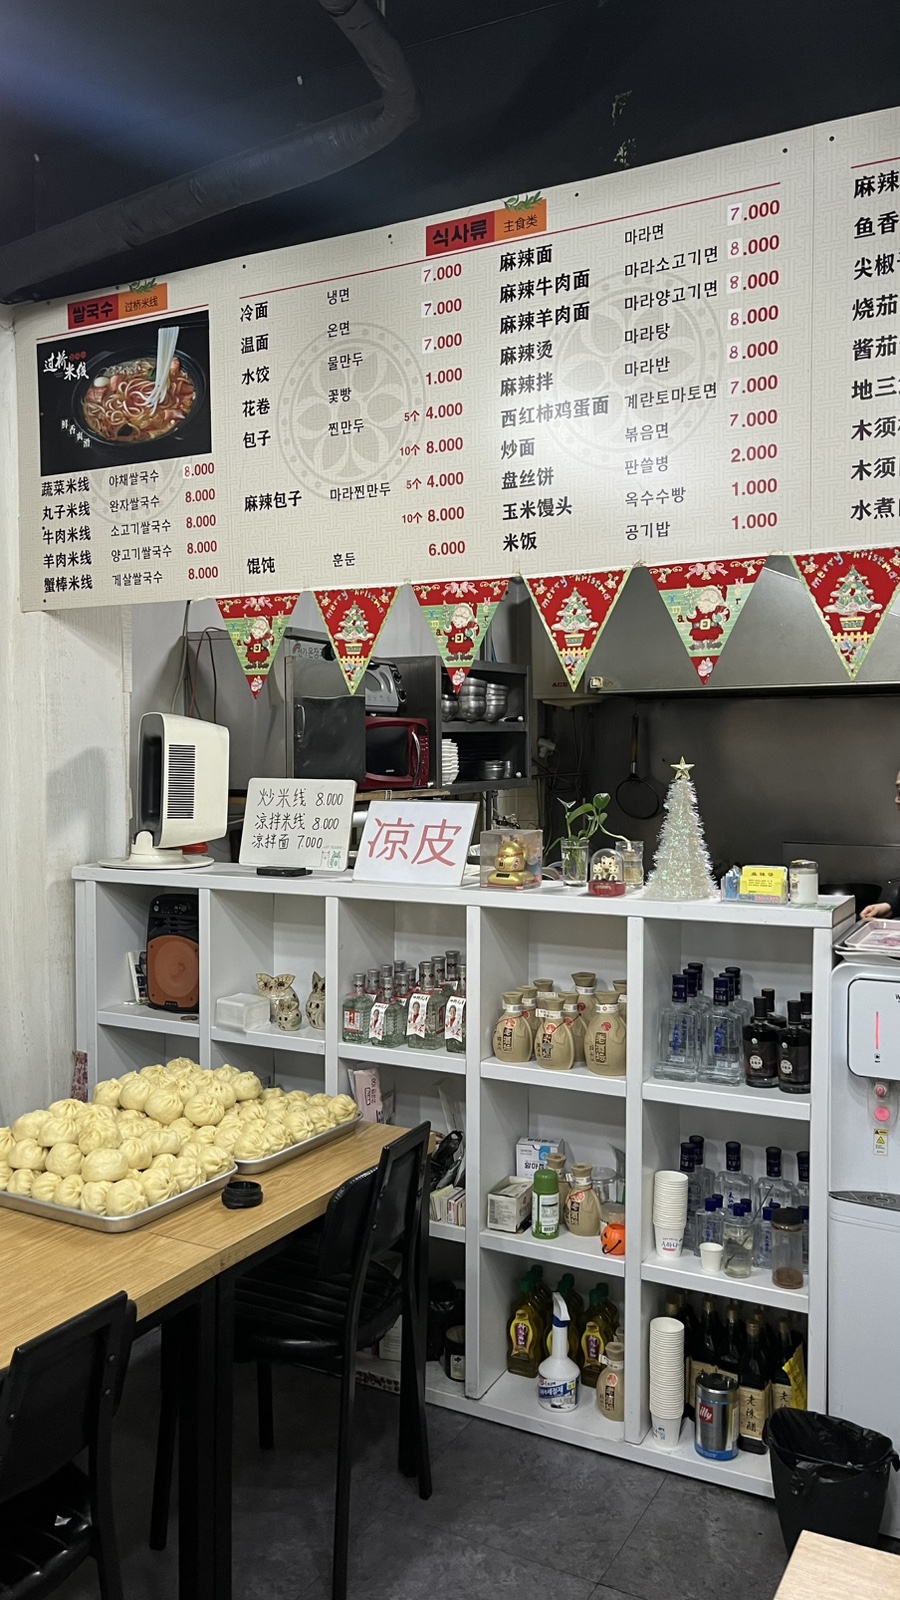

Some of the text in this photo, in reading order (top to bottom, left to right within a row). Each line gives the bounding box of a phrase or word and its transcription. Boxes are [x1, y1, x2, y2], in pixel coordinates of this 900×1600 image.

[730, 200, 780, 221] 7.000
[432, 219, 487, 248] 식사류
[503, 214, 538, 234] 主食类
[624, 223, 664, 245] 마라면
[853, 210, 900, 240] 鱼香
[729, 235, 780, 256] 8.000
[499, 244, 553, 272] 麻辣面
[624, 246, 719, 278] 마라소고기면
[853, 252, 900, 281] 尖椒
[423, 263, 462, 283] 7.000
[729, 270, 780, 291] 8.000
[499, 268, 590, 303] 麻辣牛肉面
[624, 280, 719, 311] 마라양고기면
[124, 296, 158, 313] 过桥米线
[327, 288, 350, 305] 냉면
[73, 301, 113, 324] 쌀국수
[239, 301, 268, 323] 冷面
[423, 298, 462, 316] 7.000
[729, 305, 779, 326] 8.000
[499, 301, 590, 334] 麻辣羊肉面
[327, 321, 350, 338] 온면
[624, 322, 670, 344] 마라탕
[240, 333, 269, 354] 温面
[423, 333, 463, 351] 7.000
[729, 340, 779, 360] 8.000
[327, 352, 364, 371] 물만두
[499, 340, 553, 366] 麻辣烫
[241, 365, 270, 386] 水饺
[425, 368, 463, 385] 1.000
[624, 356, 670, 377] 마라반
[500, 371, 554, 397] 麻辣拌
[729, 375, 778, 395] 7.000
[851, 375, 900, 401] 地三
[328, 387, 352, 404] 꽃빵
[624, 382, 717, 410] 계란토마토면
[242, 397, 271, 417] 花卷
[404, 402, 463, 422] 5个 4.000
[500, 395, 609, 428] 西红柿鸡蛋面
[328, 418, 365, 437] 찐만두
[729, 409, 778, 428] 7.000
[851, 415, 900, 441] 木须
[243, 429, 271, 449] 包子
[624, 422, 669, 443] 볶음면
[400, 437, 464, 456] 10个 8.000
[500, 437, 535, 460] 炒面
[731, 443, 778, 463] 2.000
[183, 462, 215, 478] 8.000
[624, 455, 669, 476] 판쓸병
[851, 456, 900, 481] 木须
[41, 476, 90, 497] 蔬菜米线
[108, 470, 160, 488] 야채쌀국수
[406, 471, 464, 489] 5个 4.000
[501, 466, 554, 490] 盘丝饼
[731, 478, 778, 496] 1.000
[185, 488, 216, 503] 8.000
[244, 490, 302, 512] 麻辣包子
[329, 482, 391, 501] 마라찐만두
[624, 486, 686, 508] 옥수수빵
[42, 501, 91, 521] 丸子米线
[109, 495, 160, 513] 완자쌀국수
[502, 496, 573, 521] 玉米馒头
[850, 496, 900, 521] 水煮
[186, 514, 216, 529] 8.000
[402, 506, 465, 524] 10个 8.000
[731, 512, 778, 530] 1.000
[42, 526, 91, 545] 牛肉米线
[110, 518, 171, 537] 소고기쌀국수
[625, 521, 670, 541] 공기밥
[186, 540, 218, 555] 8.000
[428, 540, 466, 556] 6.000
[502, 531, 537, 552] 米饭
[43, 551, 92, 569] 羊肉米线
[110, 544, 172, 562] 양고기쌀국수
[332, 552, 356, 567] 훈둔
[188, 566, 219, 580] 8.000
[246, 556, 276, 575] 馄饨
[43, 574, 93, 594] 蟹棒米线
[112, 570, 163, 587] 게살쌀국수
[257, 788, 344, 809] 炒米线 8.000
[254, 812, 340, 832] 凉拌米线 8.000
[251, 834, 323, 850] 凉拌面 7.000
[367, 817, 462, 867] 凉皮
[700, 1406, 712, 1420] illy
